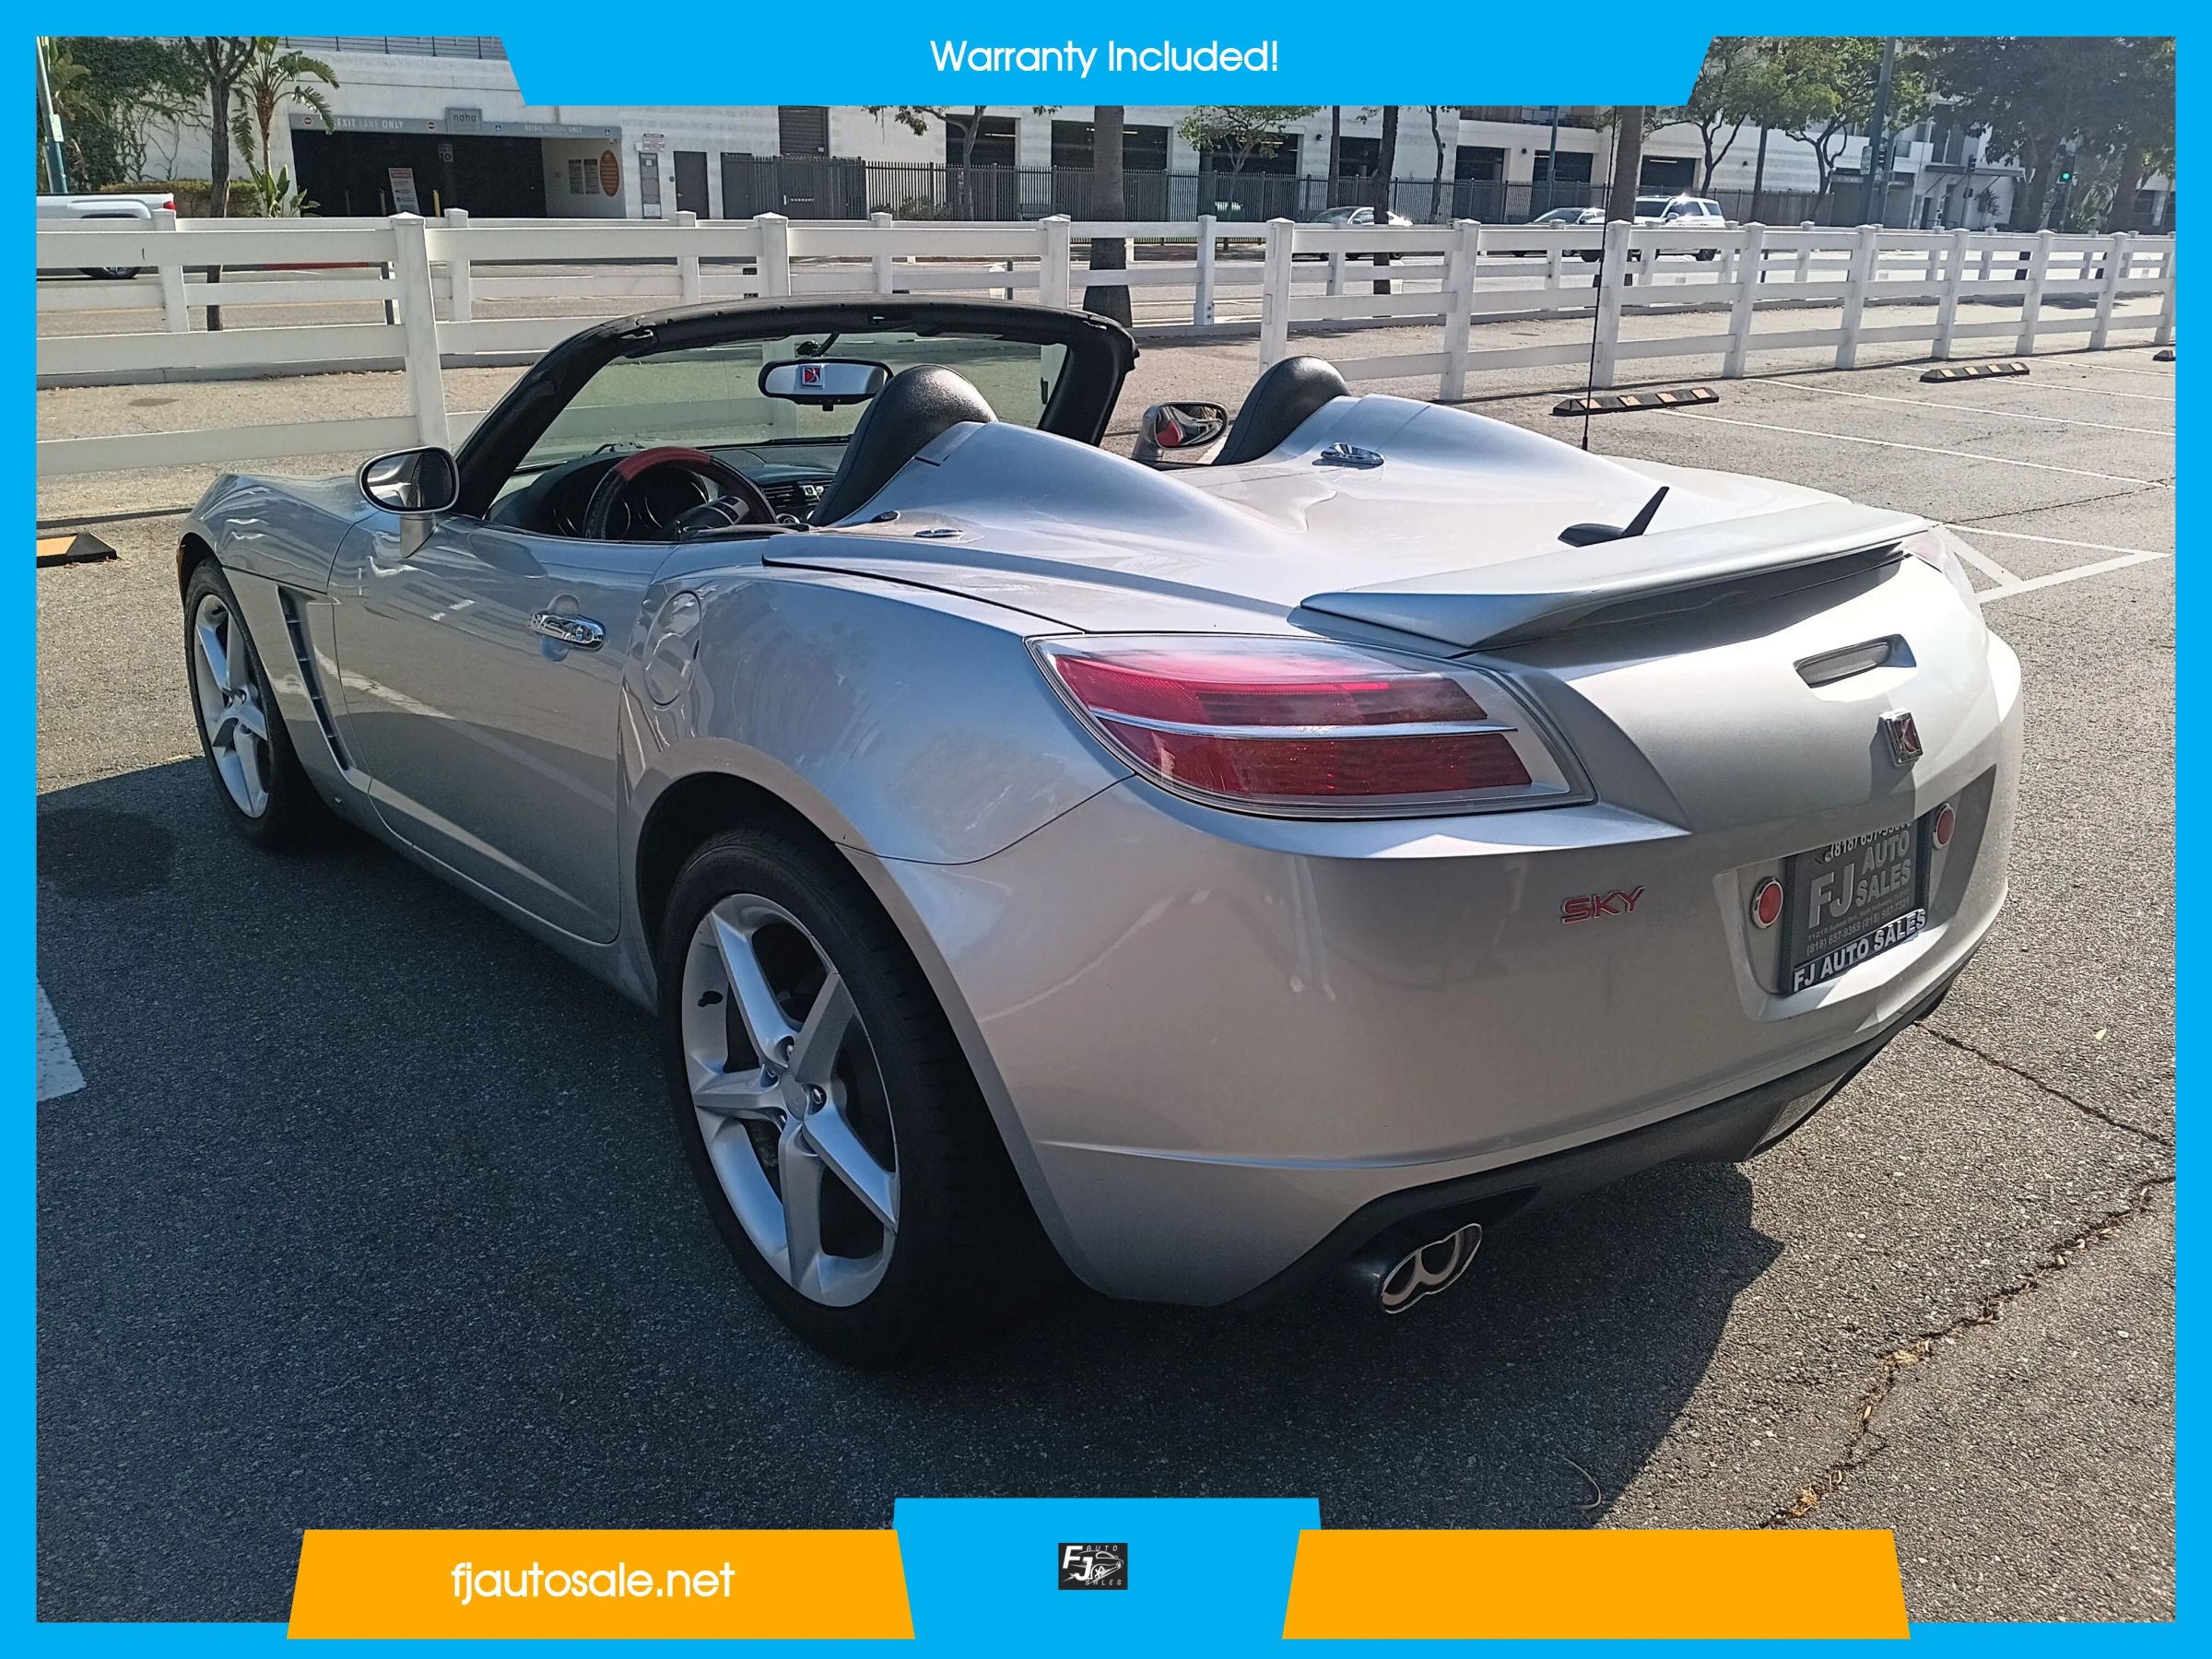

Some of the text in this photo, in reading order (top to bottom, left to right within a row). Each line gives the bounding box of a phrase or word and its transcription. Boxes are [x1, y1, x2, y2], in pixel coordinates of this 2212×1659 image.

[337, 117, 356, 127] EXIT
[382, 119, 404, 129] ONLY
[1862, 830, 1911, 875] AUTO
[1562, 886, 1646, 924] SKY
[1807, 862, 1855, 929] FJ
[1855, 858, 1912, 908] SALES
[1794, 909, 1926, 993] FJ AUTO SALES
